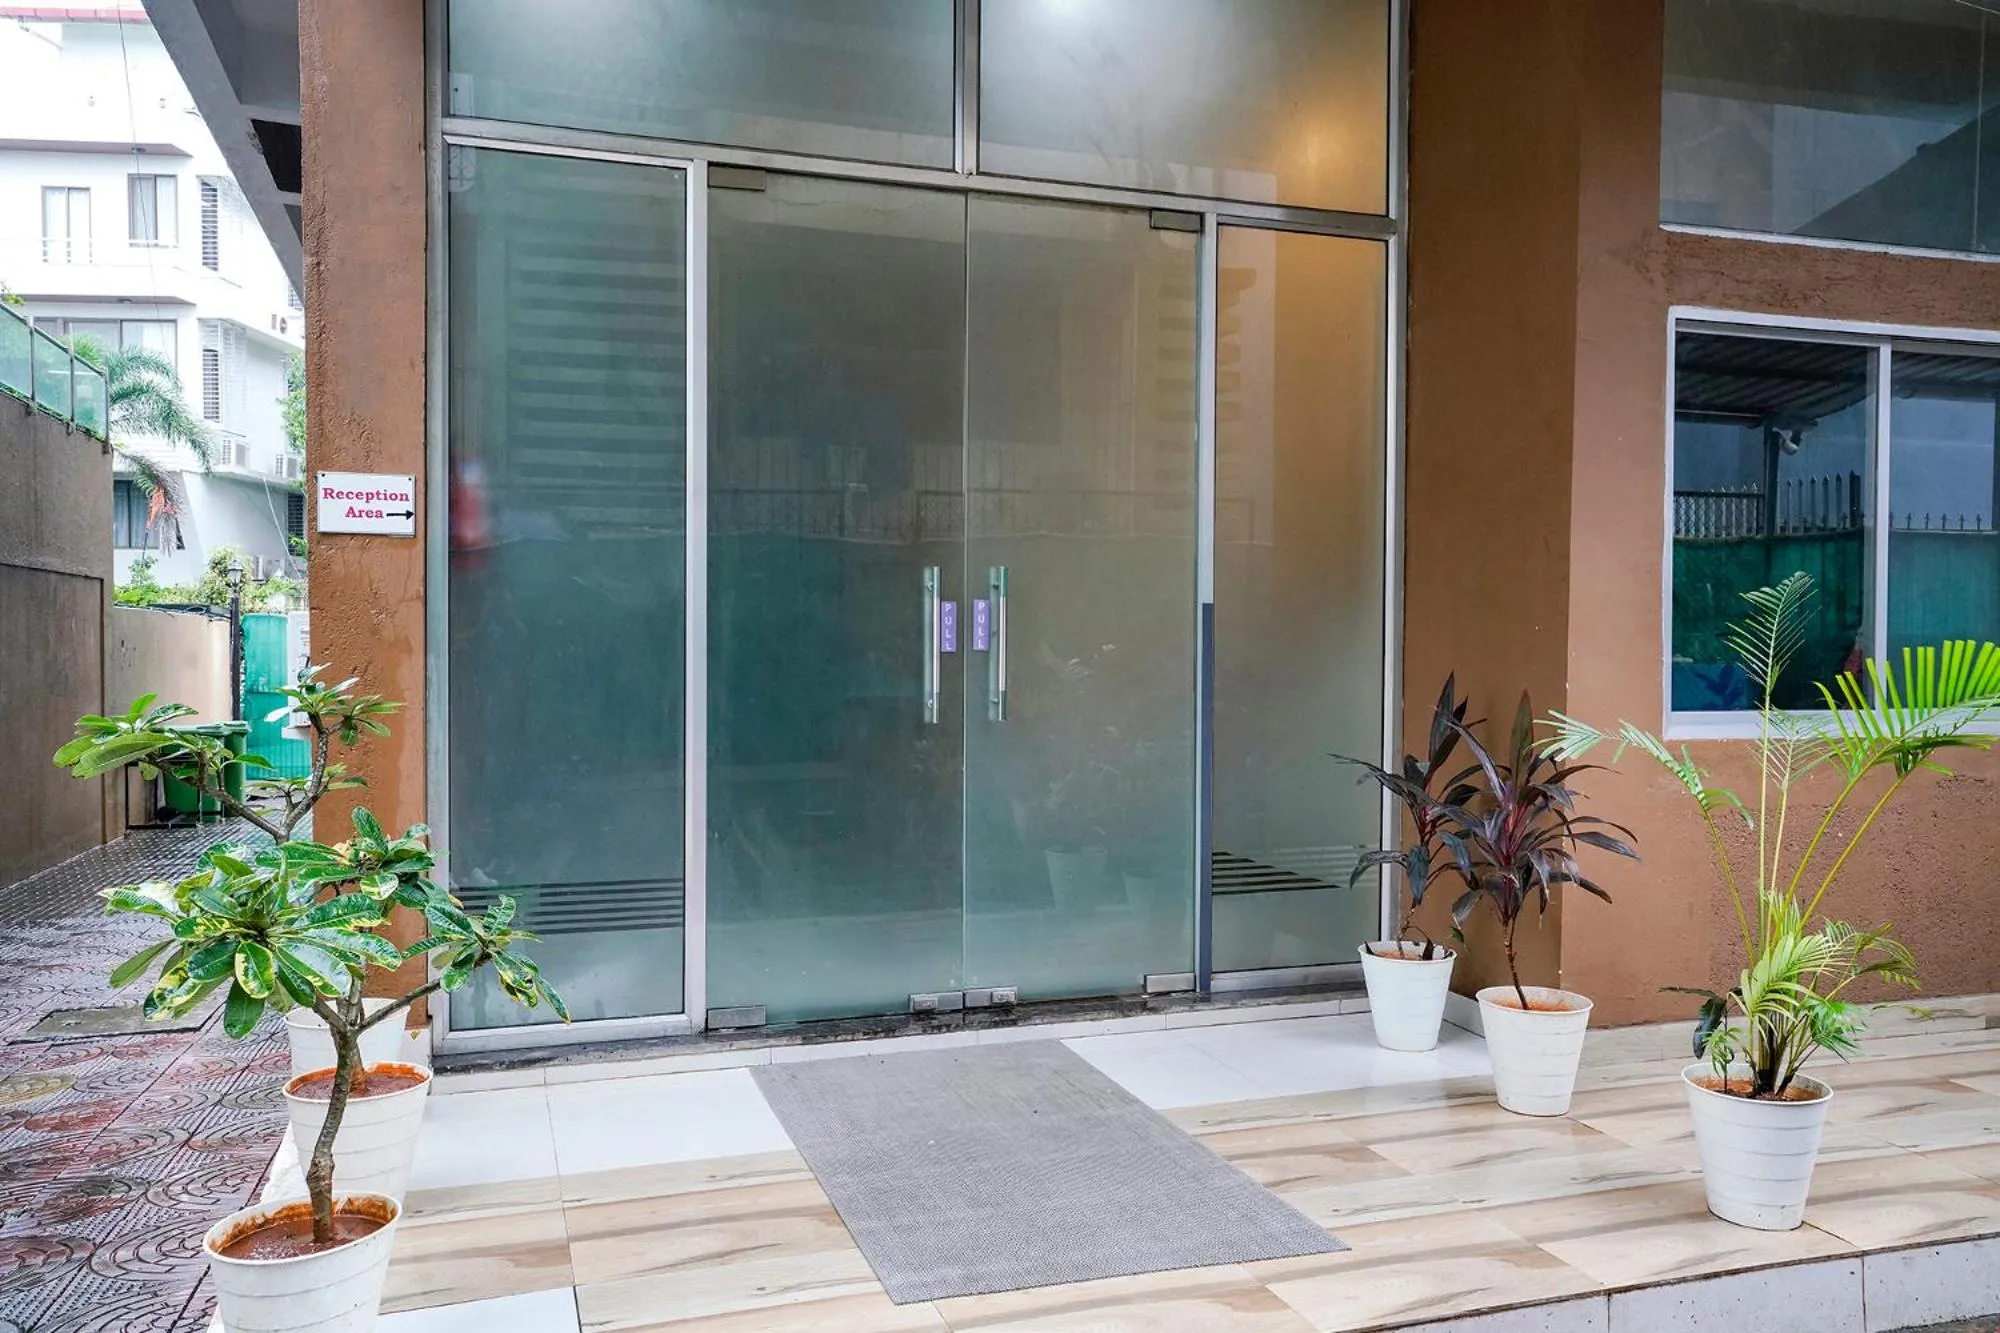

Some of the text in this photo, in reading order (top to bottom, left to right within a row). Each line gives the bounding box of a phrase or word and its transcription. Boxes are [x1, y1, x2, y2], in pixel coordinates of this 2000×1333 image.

[322, 487, 410, 503] Reception
[345, 506, 384, 518] Area
[944, 603, 952, 650] PULL
[978, 601, 986, 649] PULL
